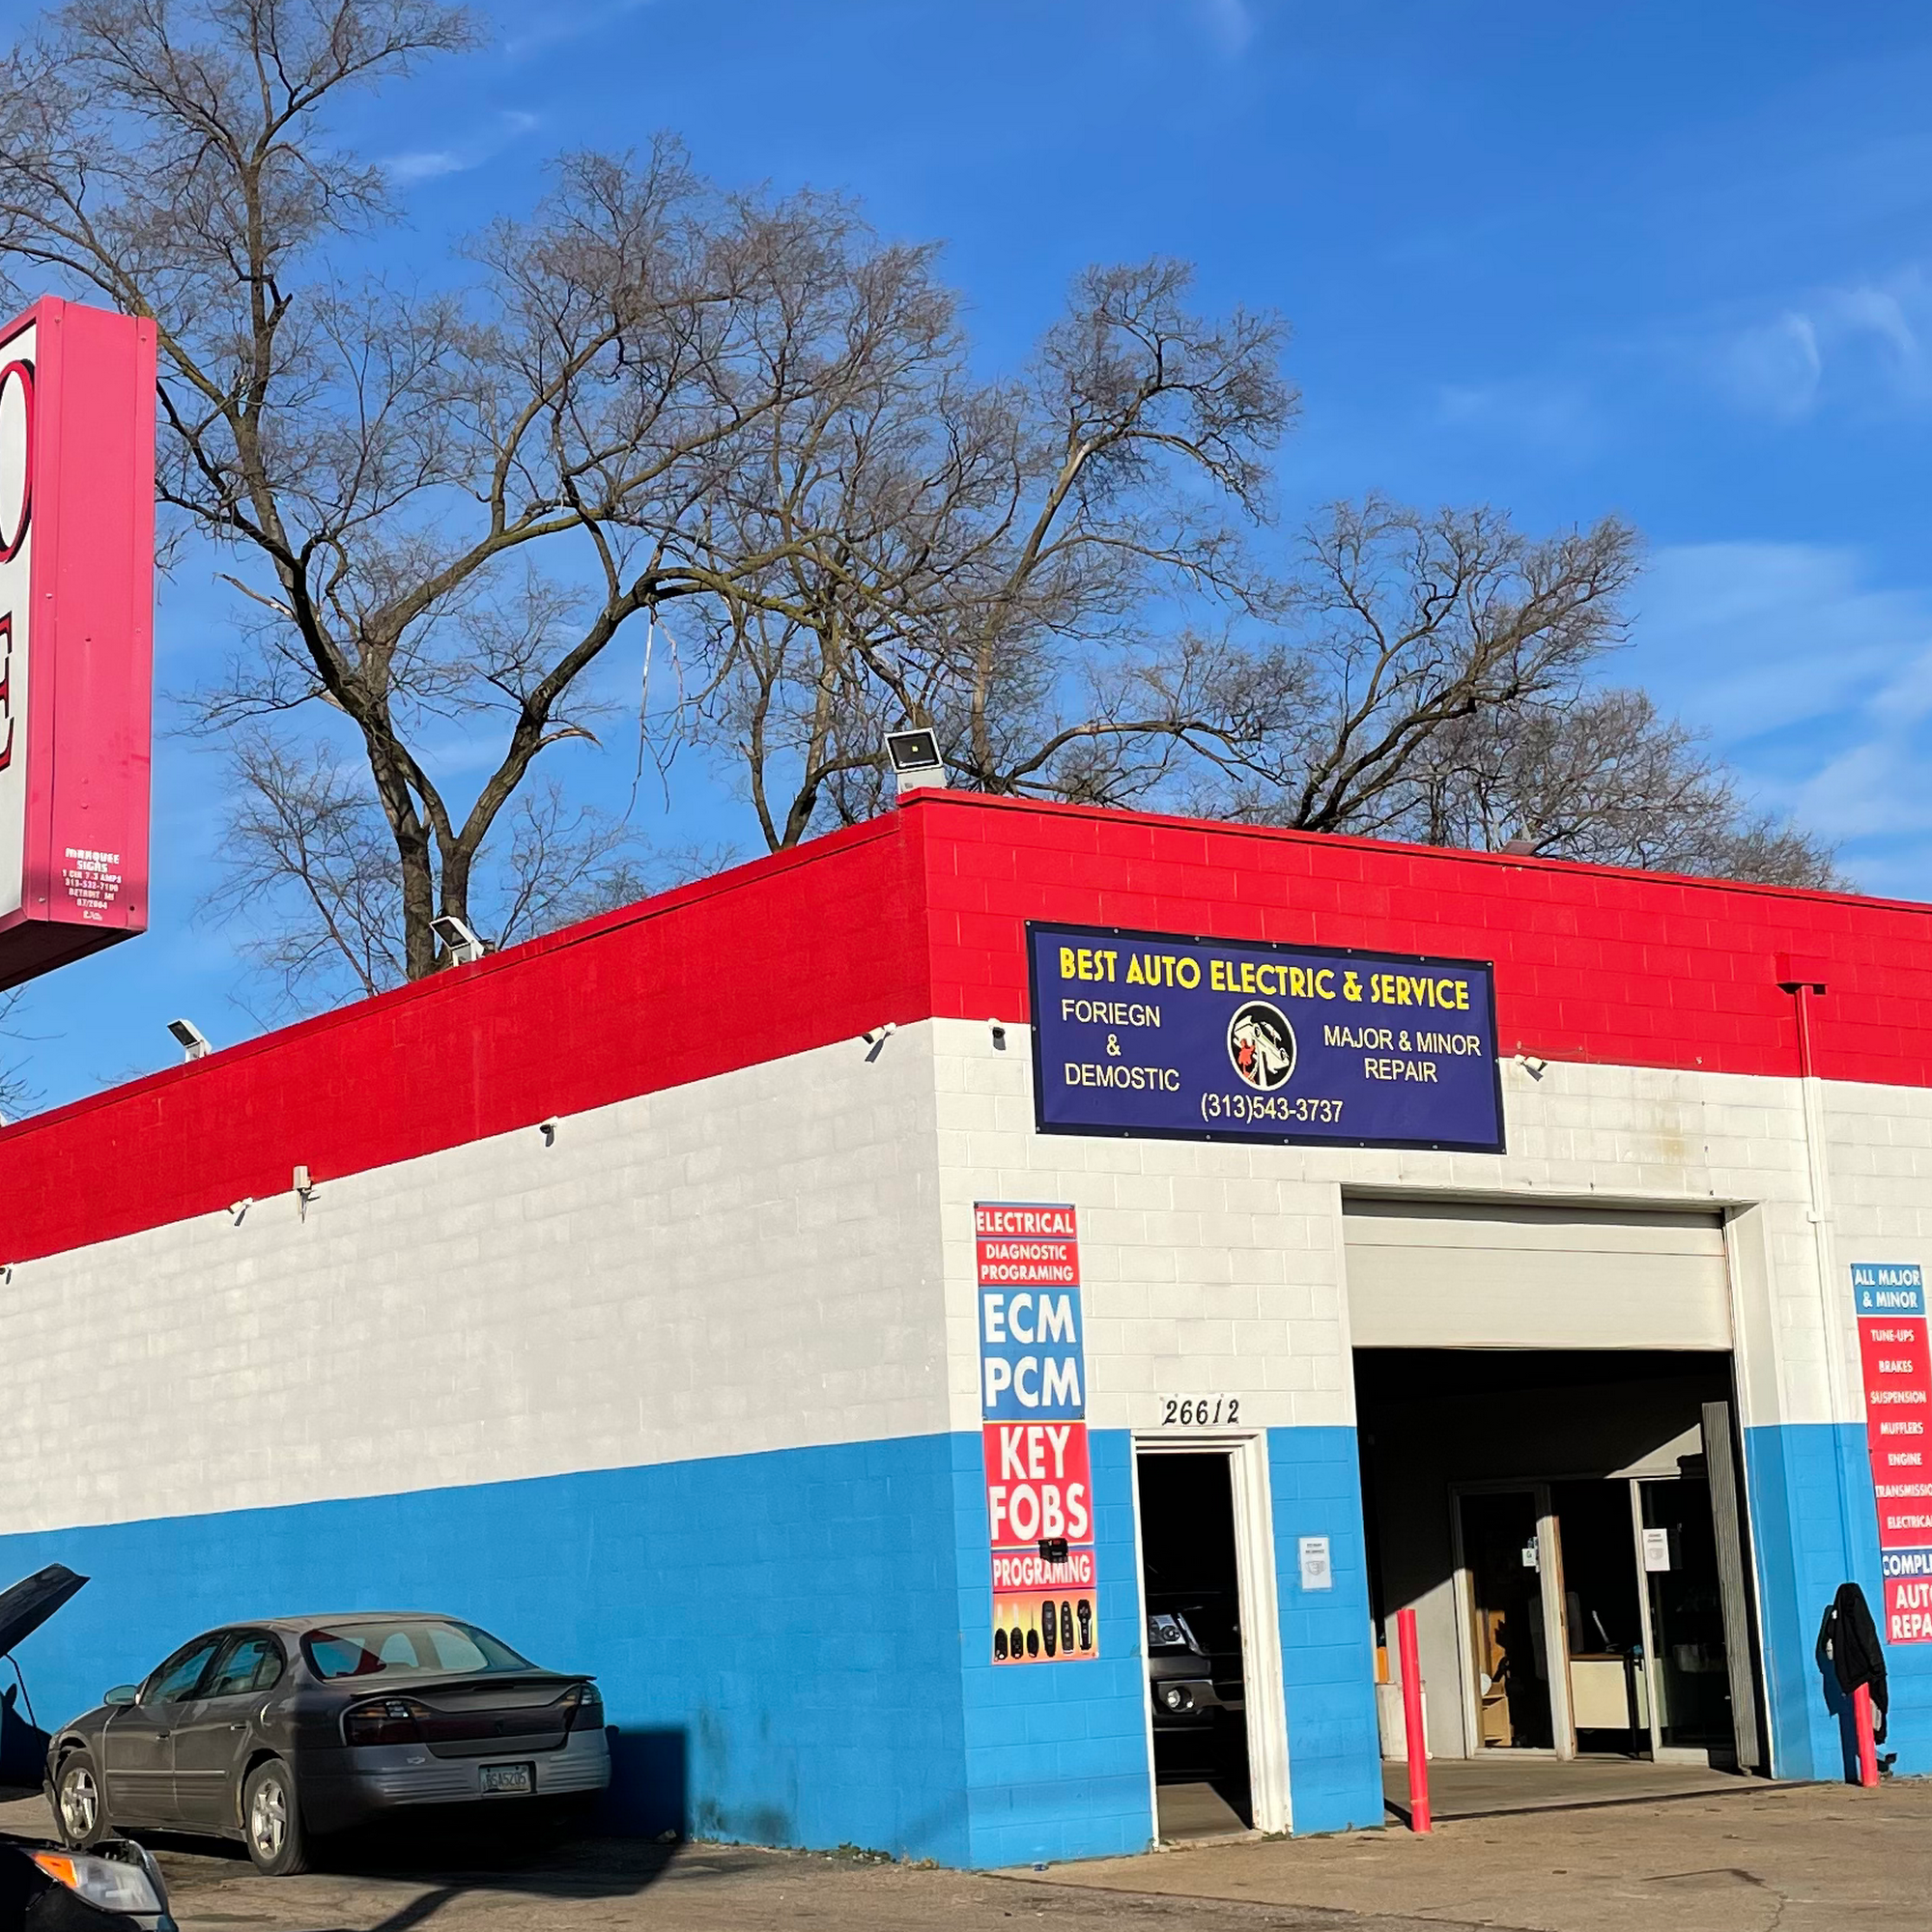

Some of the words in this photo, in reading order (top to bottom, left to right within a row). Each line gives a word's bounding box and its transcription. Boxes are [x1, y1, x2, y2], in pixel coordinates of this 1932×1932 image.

[65, 847, 120, 865] MARQUEE
[76, 860, 108, 873] SIGNS
[1059, 947, 1118, 982] BEST
[1125, 952, 1201, 989] AUTO
[1209, 959, 1336, 1000] ELECTRIC
[1343, 971, 1363, 1002] &
[1371, 973, 1470, 1010] SERVICE
[1062, 999, 1161, 1028] FORIEGN
[1106, 1033, 1122, 1057] &
[1323, 1024, 1394, 1051] MAJOR
[1398, 1030, 1412, 1052] &
[1416, 1031, 1482, 1057] MINOR
[1065, 1063, 1180, 1092] DEMOSTIC
[1364, 1058, 1438, 1083] REPAIR
[1200, 1092, 1344, 1124] (313)543-3737
[976, 1210, 1074, 1234] ELECTRICAL
[985, 1243, 1067, 1262] DIAGNOSTIC
[980, 1264, 1074, 1282] PROGRAMING
[1854, 1269, 1875, 1286] ALL
[1878, 1269, 1921, 1287] MAJOR
[1862, 1291, 1873, 1308] &
[1876, 1291, 1918, 1308] MINOR
[983, 1293, 1077, 1344] ECM
[1870, 1328, 1915, 1343] TUNE-UPS
[1878, 1360, 1914, 1374] BRAKES
[984, 1356, 1082, 1407] PCM
[1870, 1390, 1927, 1405] SUSPENSION
[1161, 1399, 1239, 1426] 26612
[1880, 1422, 1924, 1435] MUFFLERS
[1000, 1425, 1071, 1480] KEY
[1888, 1452, 1922, 1466] ENGINE
[989, 1483, 1088, 1541] FOBS
[993, 1554, 1092, 1587] PROGRAMING
[1895, 1583, 1932, 1609] AUT
